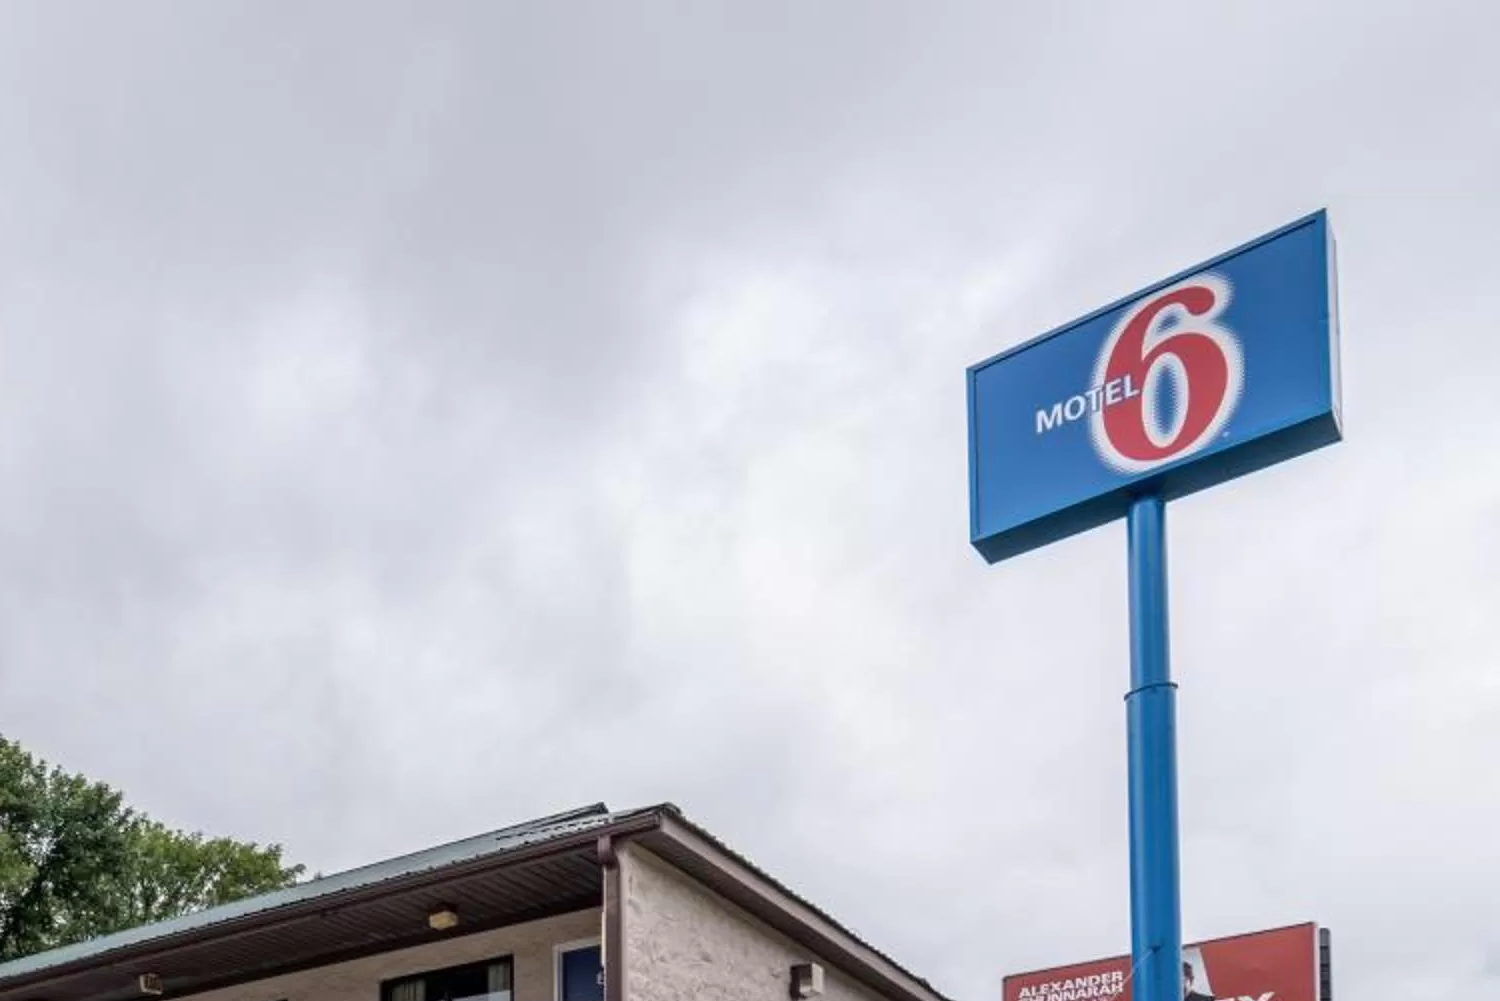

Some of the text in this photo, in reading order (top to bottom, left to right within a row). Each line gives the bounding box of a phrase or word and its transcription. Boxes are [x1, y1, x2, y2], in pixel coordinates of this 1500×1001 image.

[1035, 280, 1234, 467] MOTEL 6
[1019, 971, 1123, 998] ALEXANDER
